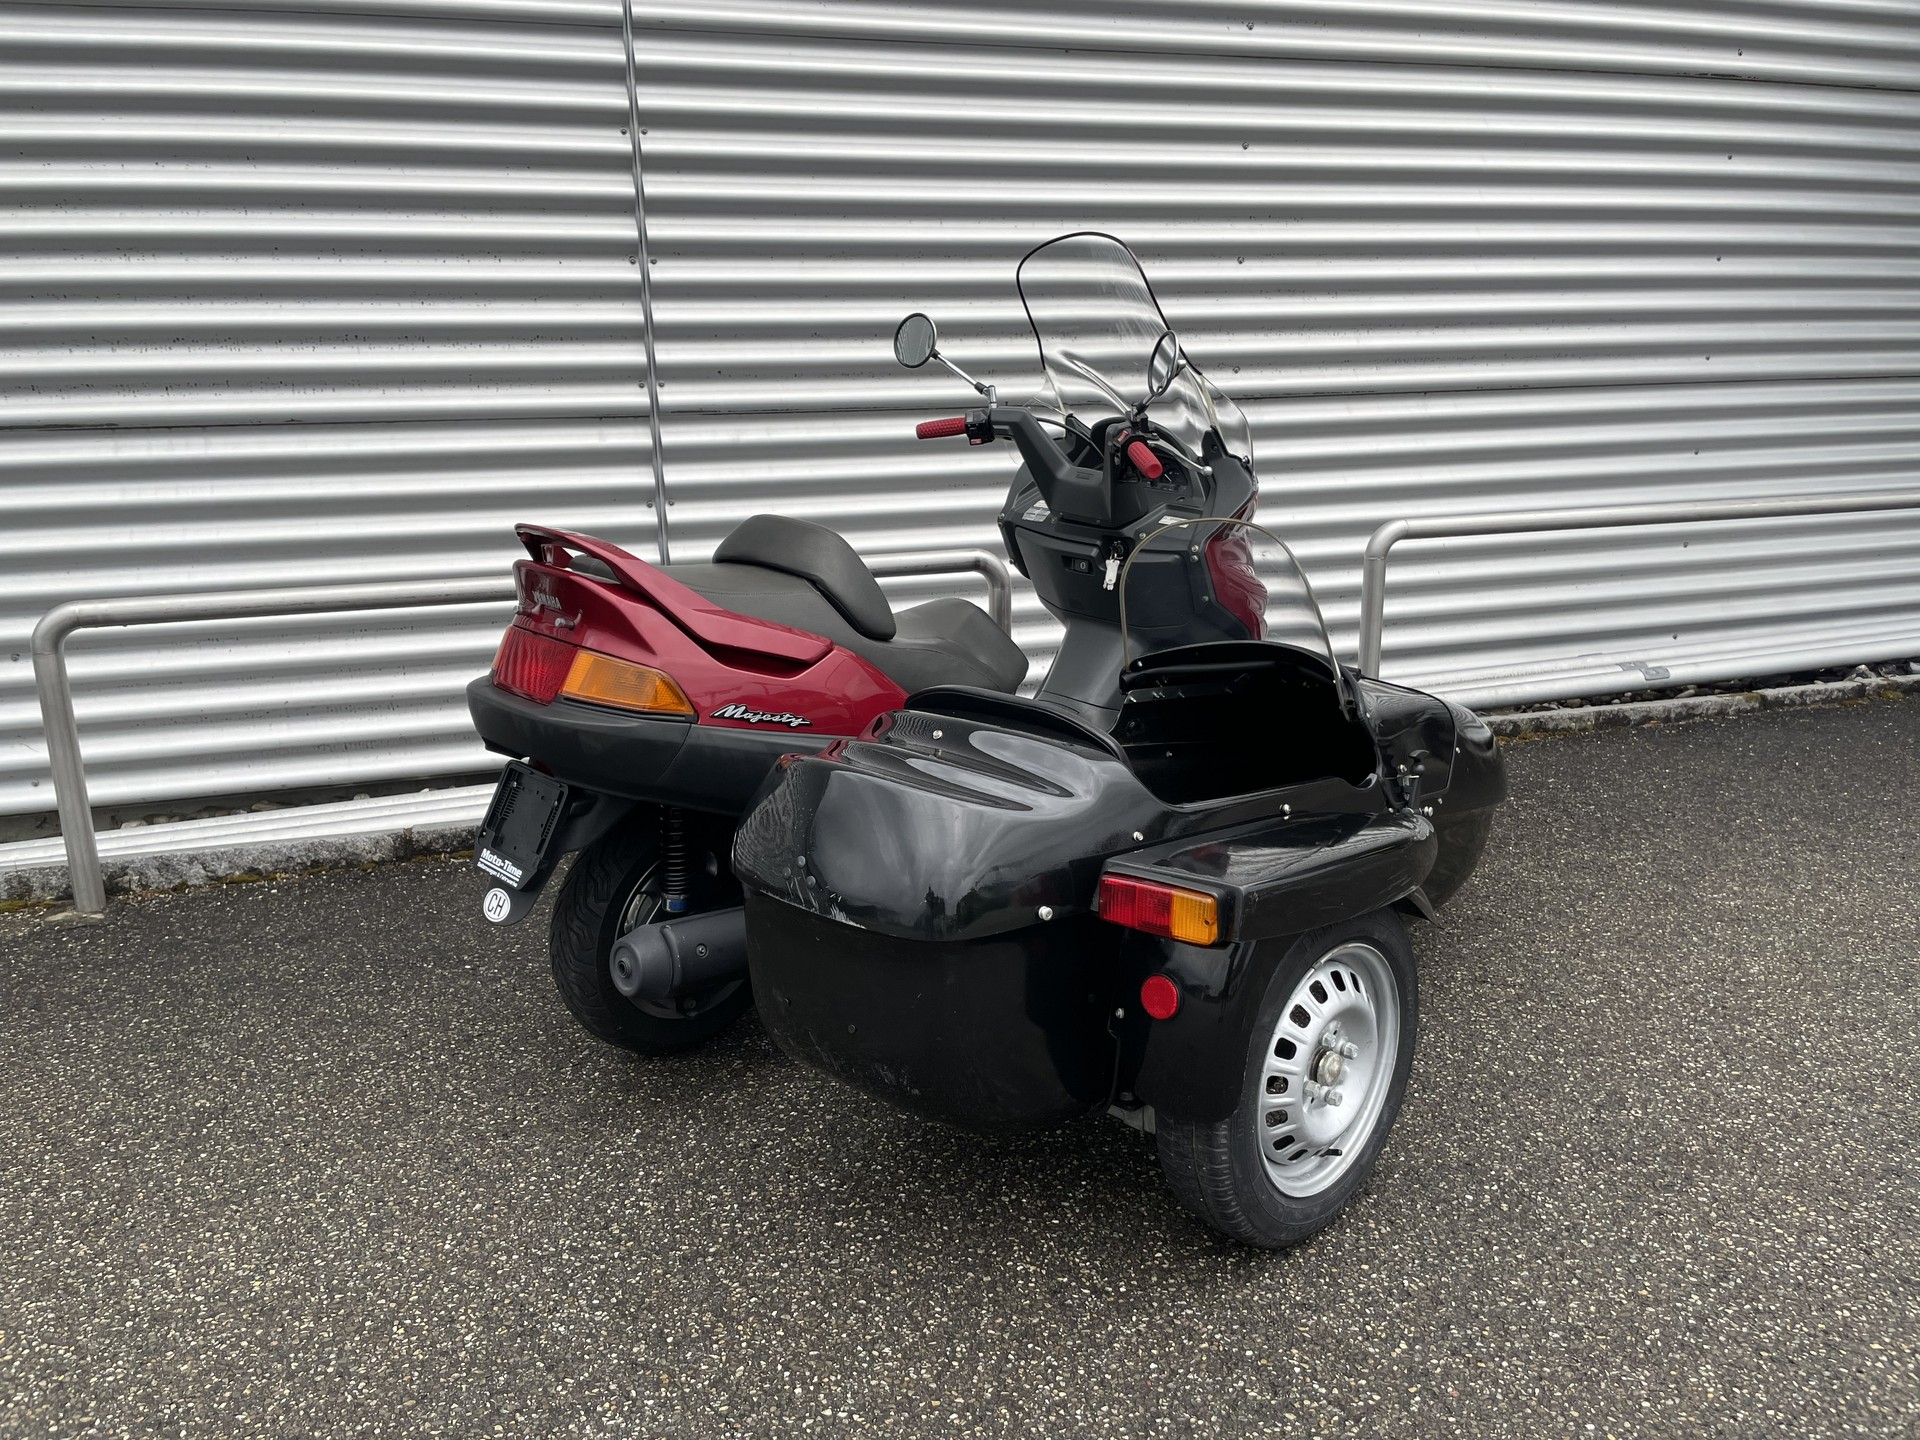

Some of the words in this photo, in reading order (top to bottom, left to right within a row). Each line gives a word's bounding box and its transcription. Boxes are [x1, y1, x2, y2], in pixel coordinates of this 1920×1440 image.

[532, 590, 562, 610] YAMAHA
[713, 704, 811, 727] Majesty
[487, 893, 506, 917] CH
